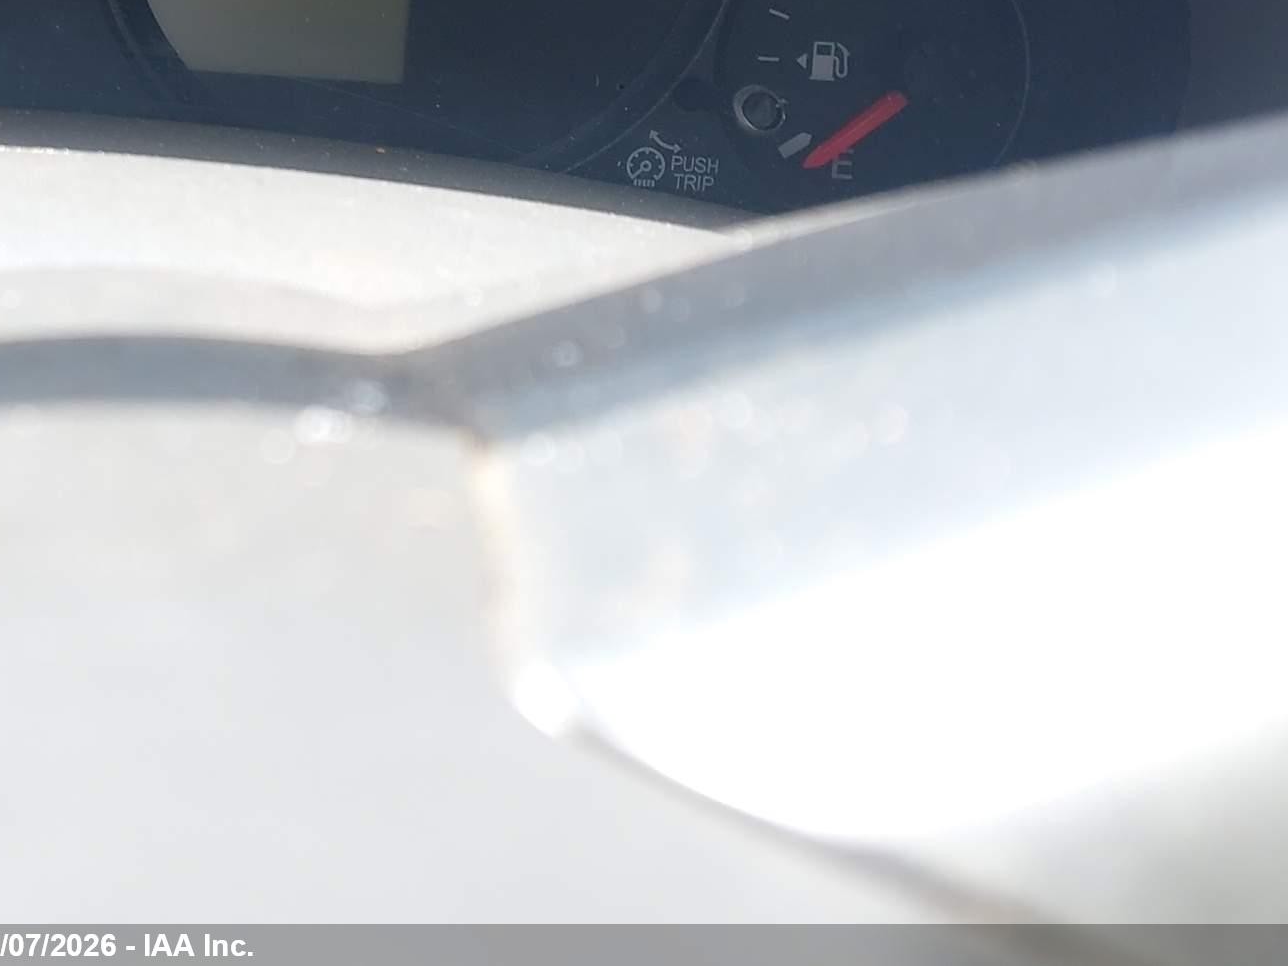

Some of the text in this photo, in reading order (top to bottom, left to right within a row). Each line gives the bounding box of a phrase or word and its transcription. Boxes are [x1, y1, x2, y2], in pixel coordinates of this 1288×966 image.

[671, 155, 719, 174] PUSH
[831, 149, 854, 180] E
[674, 174, 714, 192] TRIP
